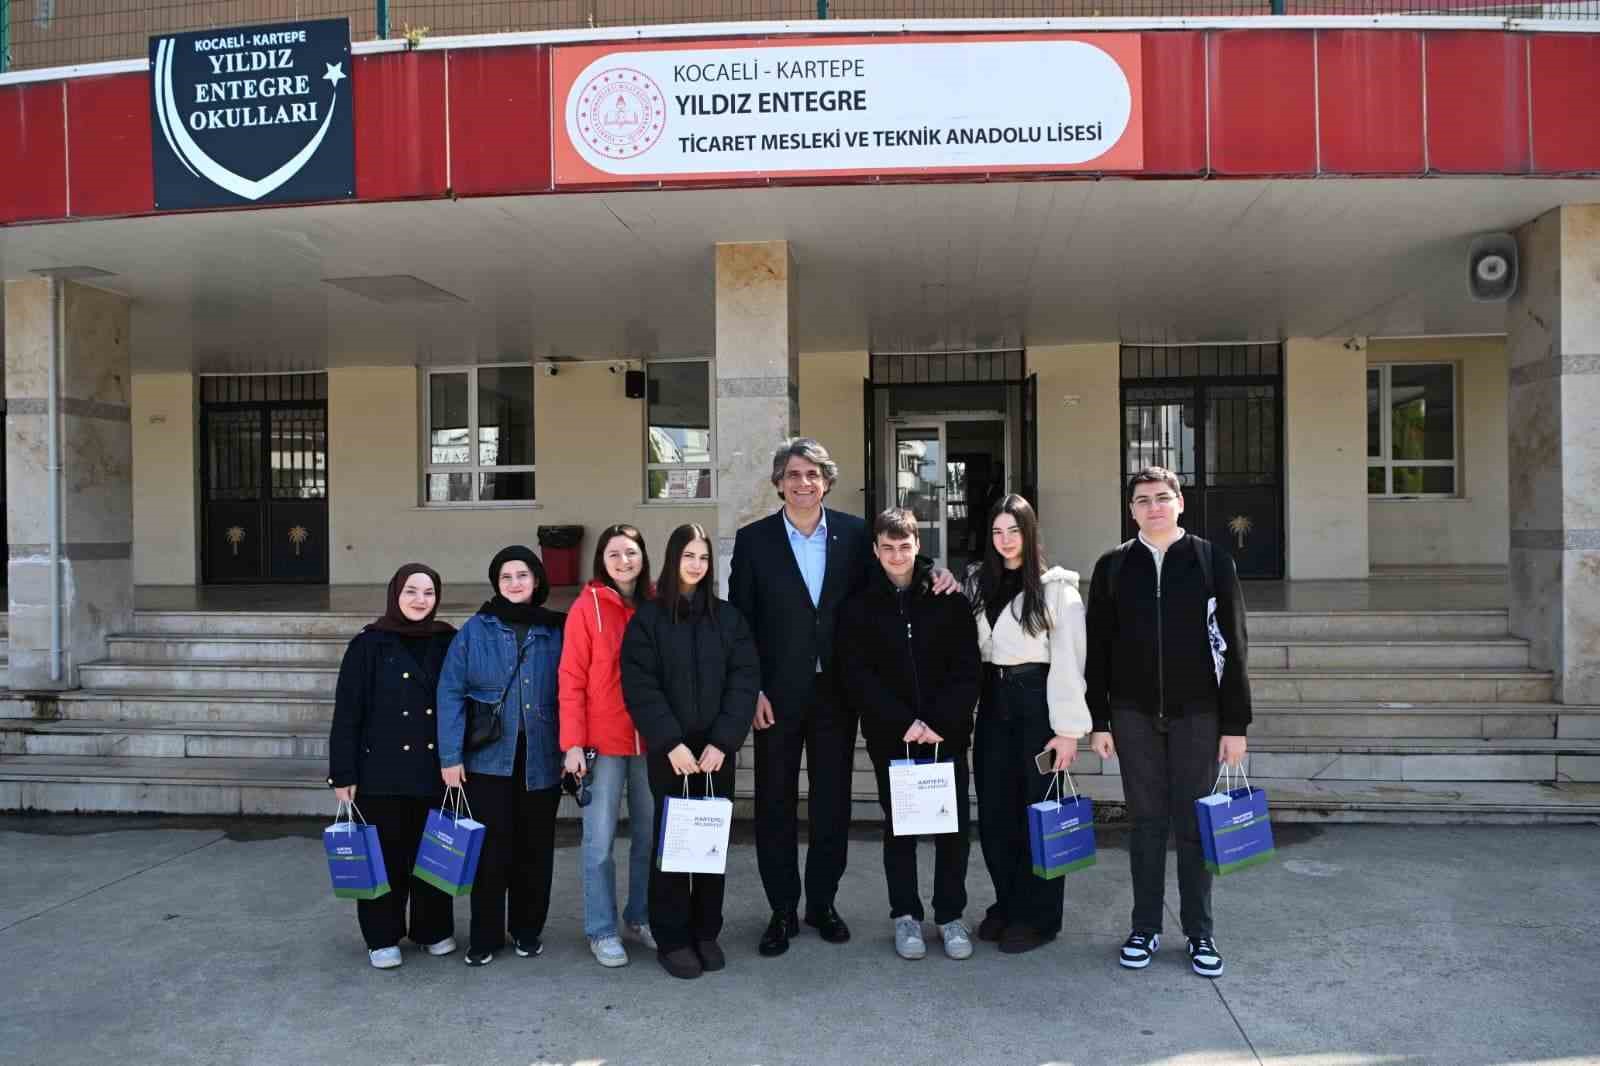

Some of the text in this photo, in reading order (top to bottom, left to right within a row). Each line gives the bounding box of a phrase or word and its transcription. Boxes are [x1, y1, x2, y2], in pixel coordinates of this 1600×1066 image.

[194, 34, 245, 52] KOCAELİ
[252, 31, 307, 47] KARTEPE
[208, 48, 294, 75] YILDIZ
[674, 58, 758, 83] KOCAELİ
[776, 59, 865, 80] KARTEPE
[194, 75, 310, 103] ENTEGRE
[189, 102, 318, 131] OKULLARI
[674, 90, 867, 116] YILDIZ ENTEGRE
[678, 121, 1103, 153] TİCARET MESLEKİ VE TEKNİK ANADOLU LİSESİ
